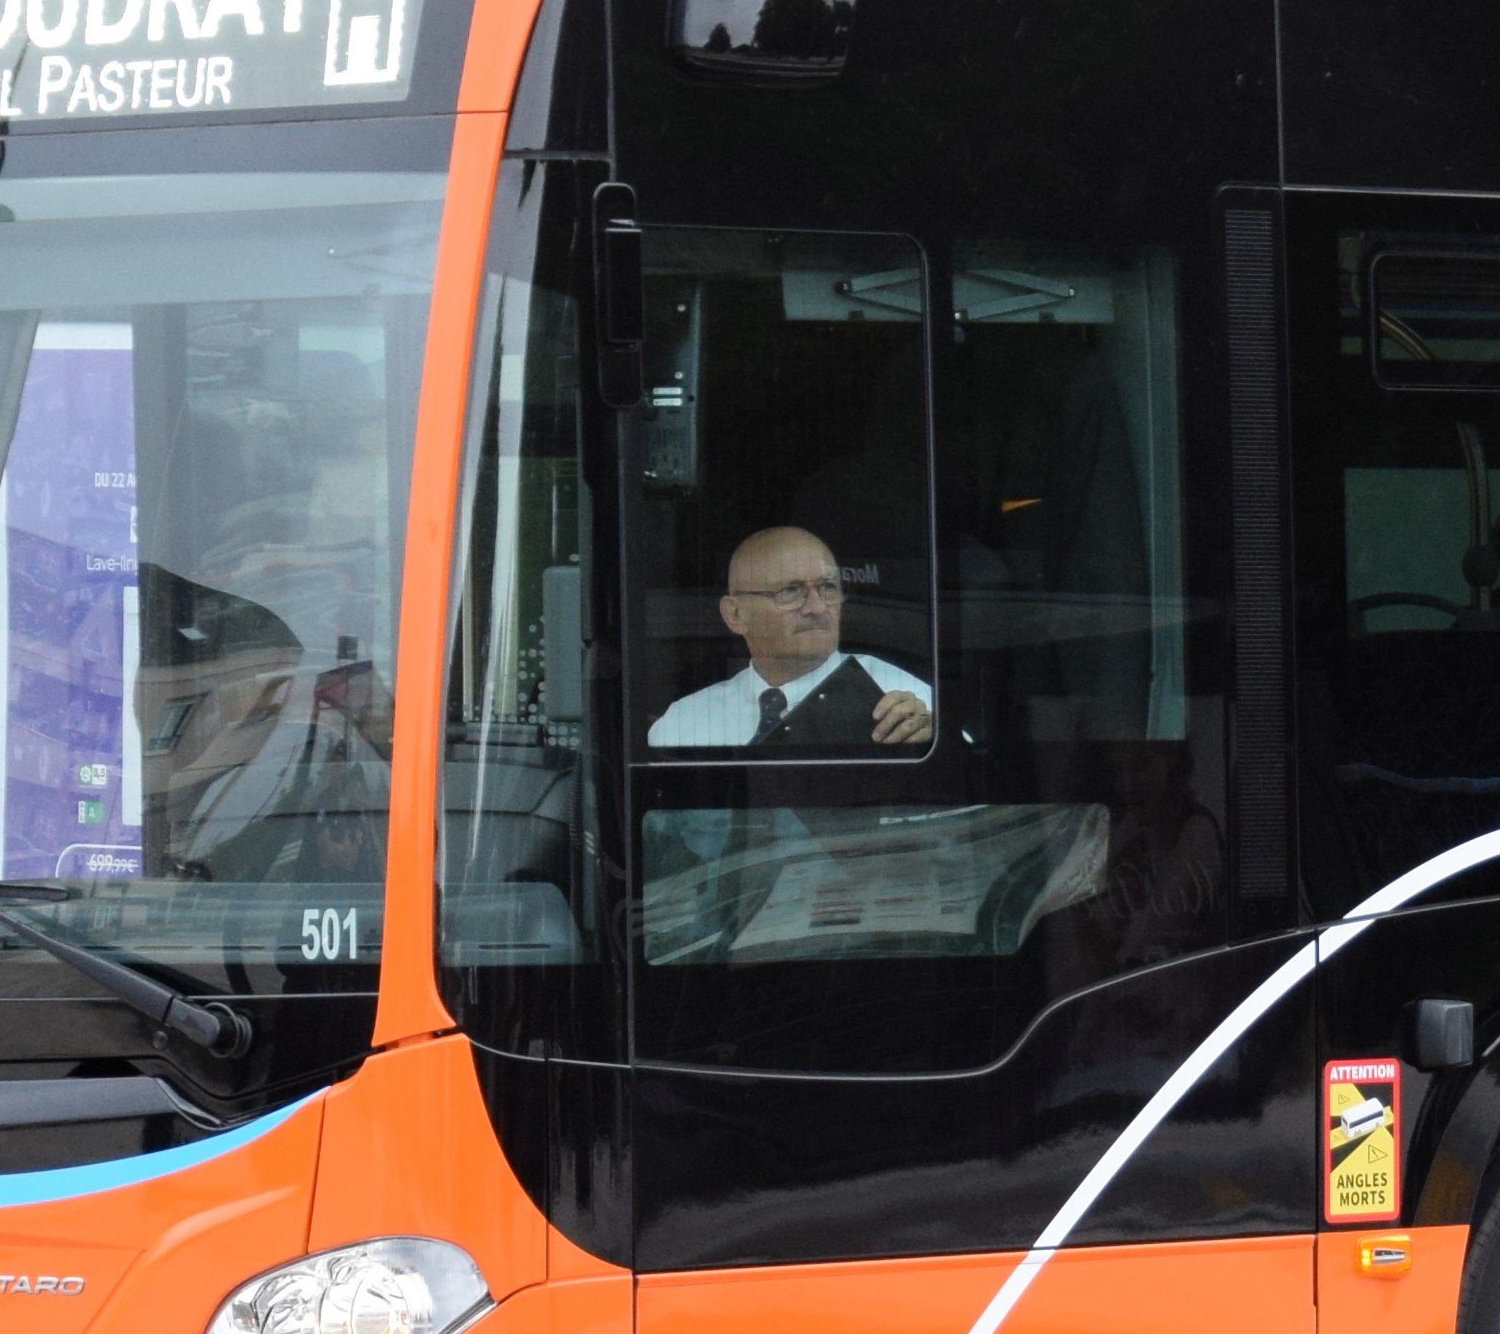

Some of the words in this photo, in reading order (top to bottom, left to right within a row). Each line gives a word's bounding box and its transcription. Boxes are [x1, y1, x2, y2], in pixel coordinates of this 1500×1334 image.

[38, 55, 233, 115] PASTEUR
[94, 472, 108, 487] DU
[111, 472, 124, 487] 22
[301, 908, 358, 961] 501
[1329, 1064, 1395, 1081] ATTENTION
[1336, 1172, 1388, 1189] ANGLES
[1339, 1190, 1386, 1207] MORTS
